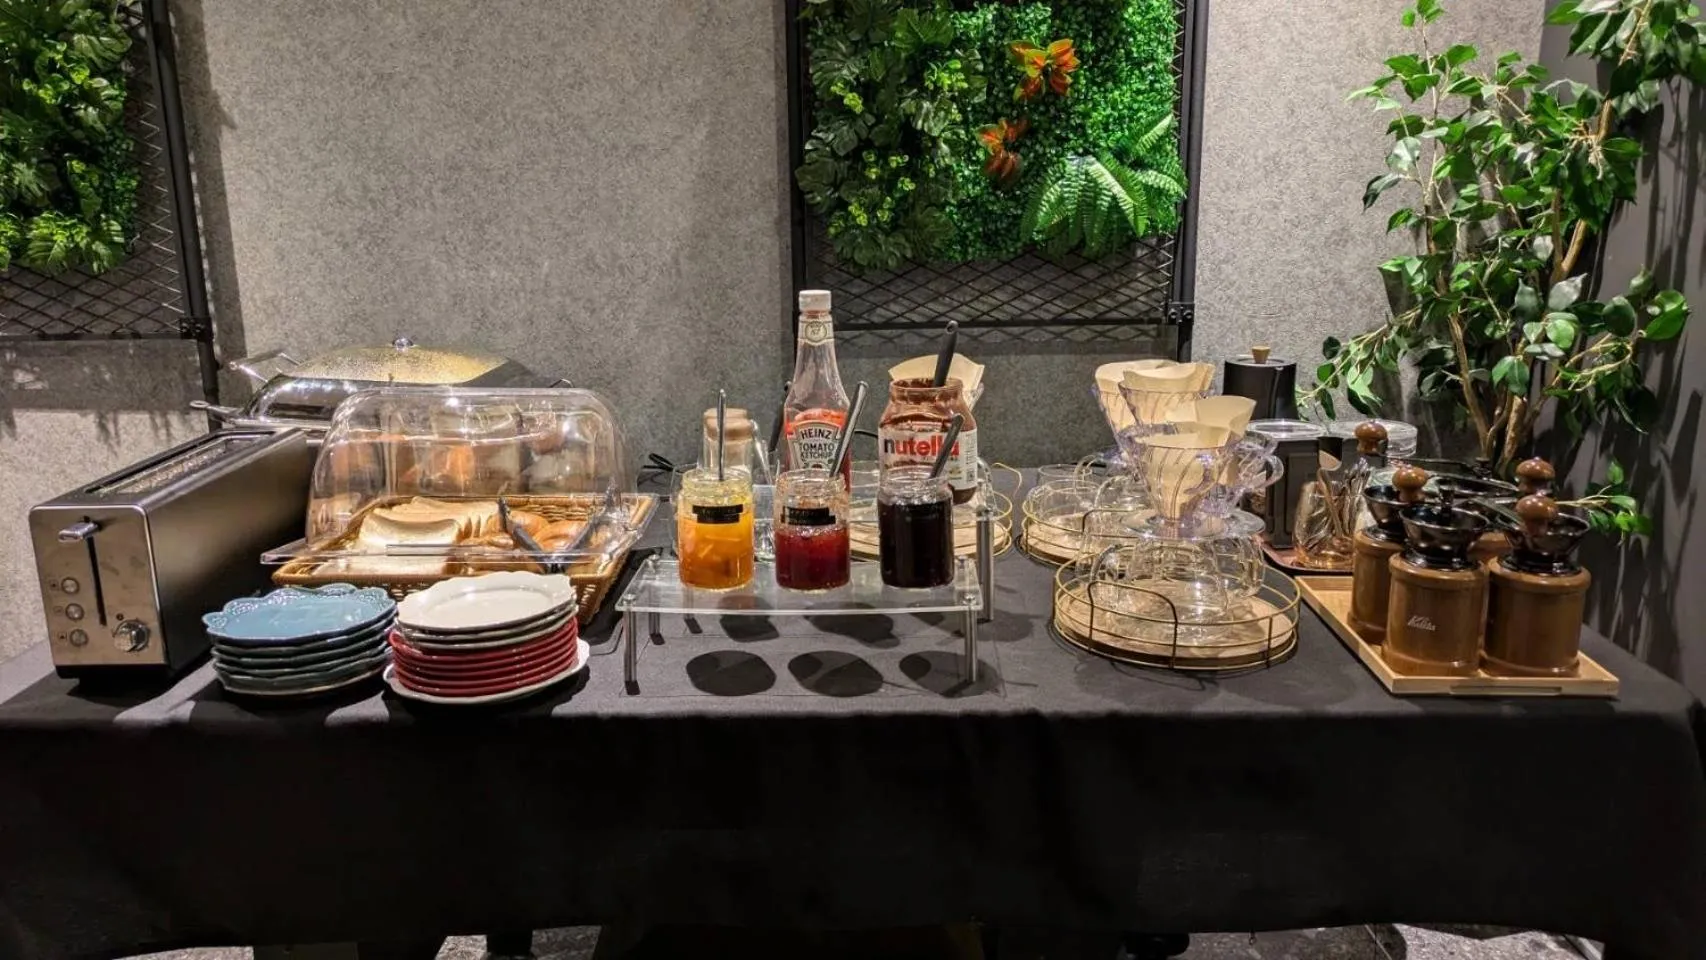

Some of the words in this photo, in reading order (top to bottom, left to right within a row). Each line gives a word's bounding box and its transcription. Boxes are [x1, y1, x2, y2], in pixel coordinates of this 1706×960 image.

[801, 428, 832, 439] HEINZ
[800, 442, 834, 451] TOMATO
[801, 451, 833, 459] KETCHUP
